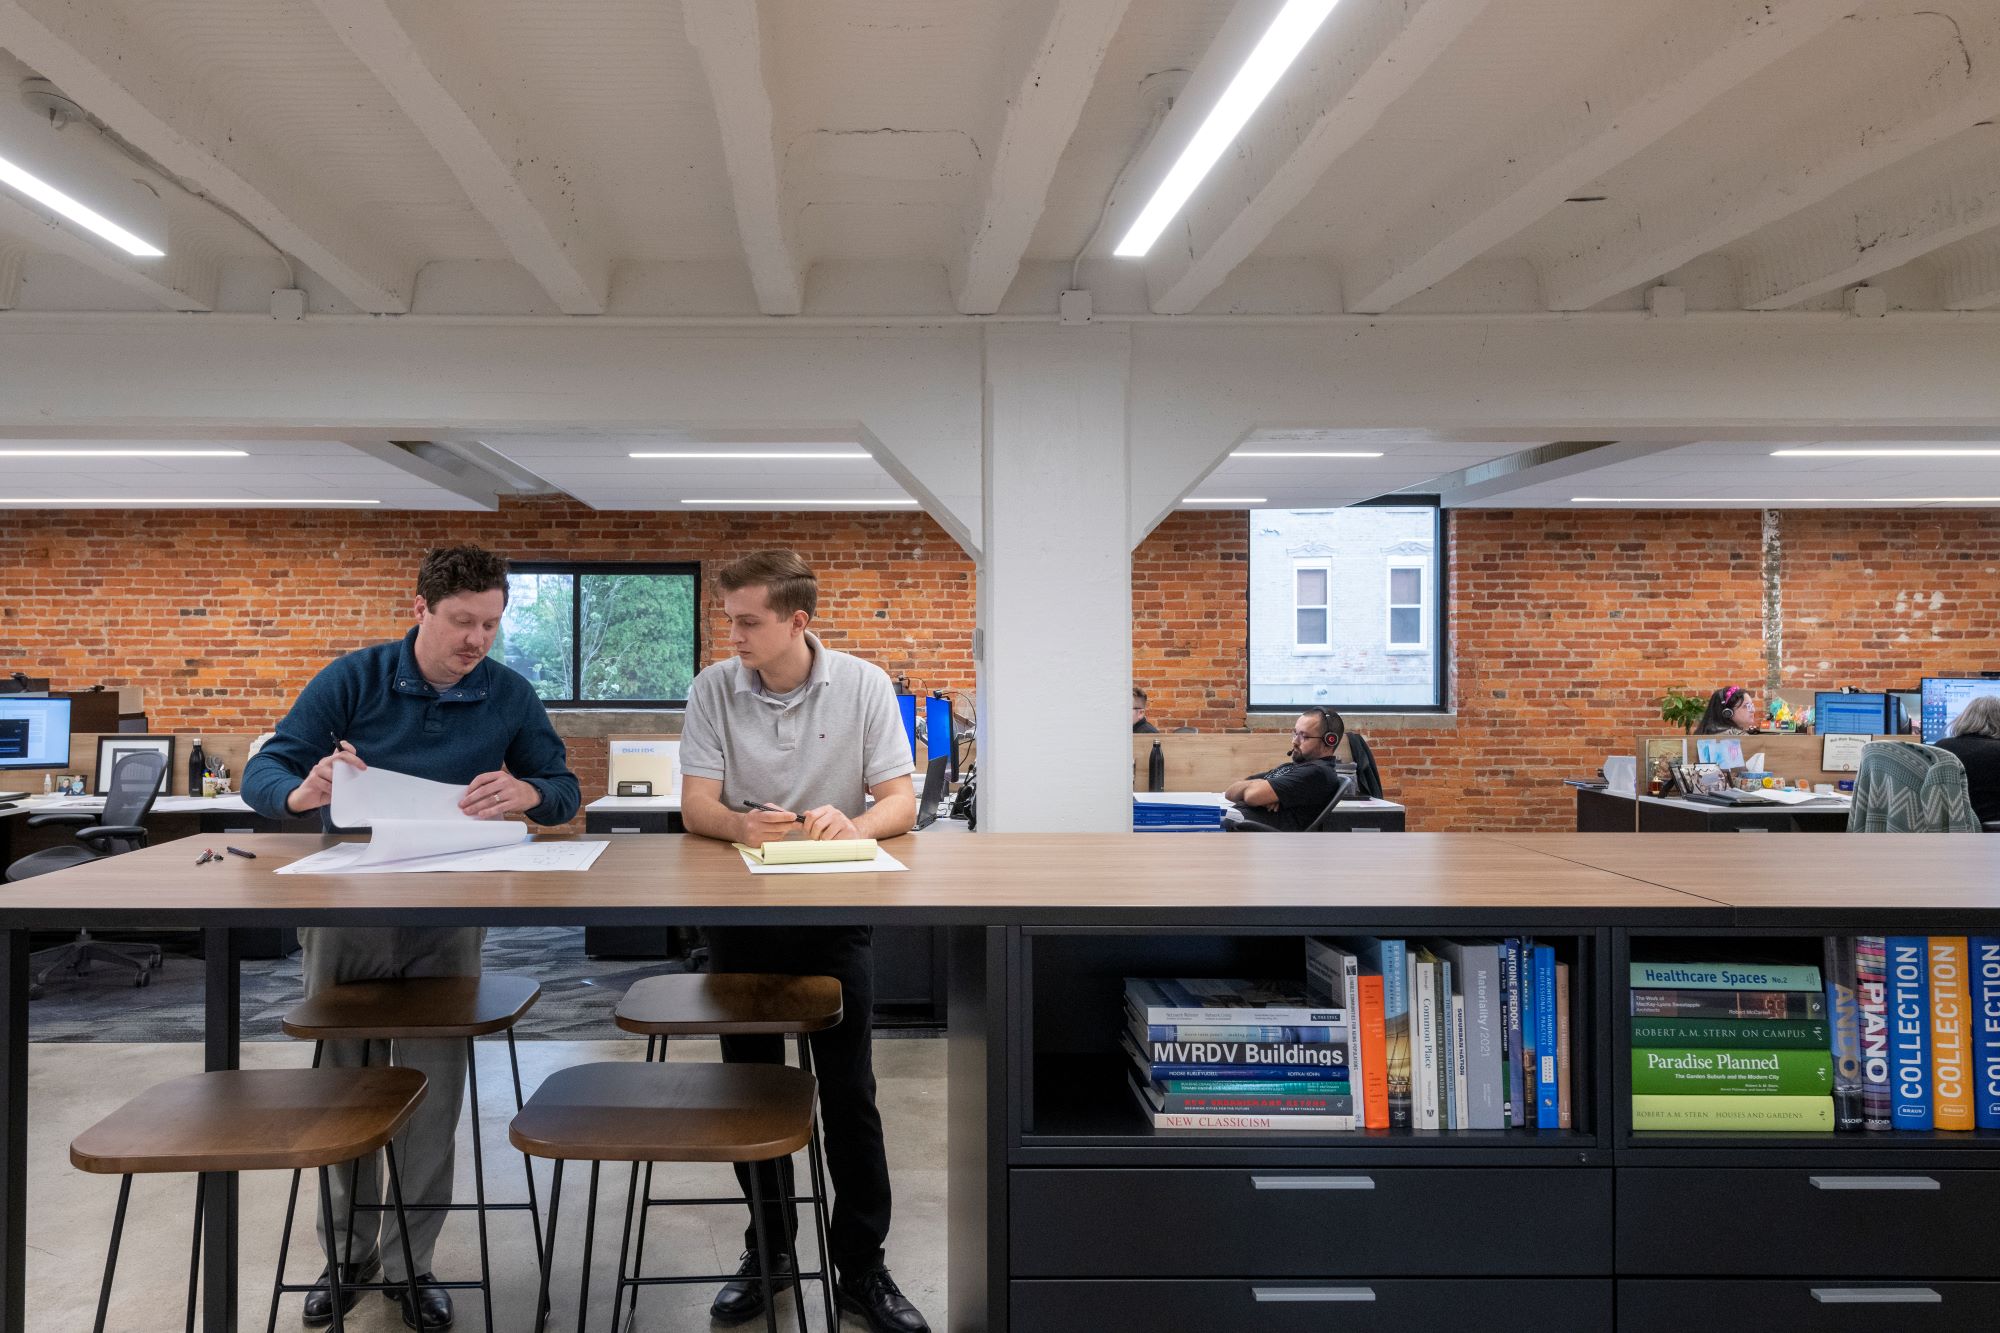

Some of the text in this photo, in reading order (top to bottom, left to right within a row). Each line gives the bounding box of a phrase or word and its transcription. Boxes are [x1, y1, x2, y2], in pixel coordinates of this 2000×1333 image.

[1508, 948, 1519, 1031] ANTOINE PREDOCK
[1645, 969, 1717, 983] Healthcare
[1722, 971, 1767, 986] Spaces
[1423, 998, 1433, 1069] Common Place
[1457, 1008, 1465, 1048] SUBURBAN
[1635, 1028, 1676, 1037] ROBERT
[1703, 1029, 1736, 1038] STERN
[1742, 1029, 1759, 1038] ON
[1762, 1029, 1806, 1038] CAMPUS
[1834, 983, 1859, 1080] ANDO
[1863, 982, 1888, 1083] PIANO
[1895, 946, 1923, 1098] COLLECTION
[1932, 945, 1962, 1098] COLLECTION
[1154, 1043, 1343, 1066] MVRDV Buildings
[1648, 1053, 1779, 1070] Paradise Planned
[1166, 1117, 1270, 1128] NEW CLASSICISM
